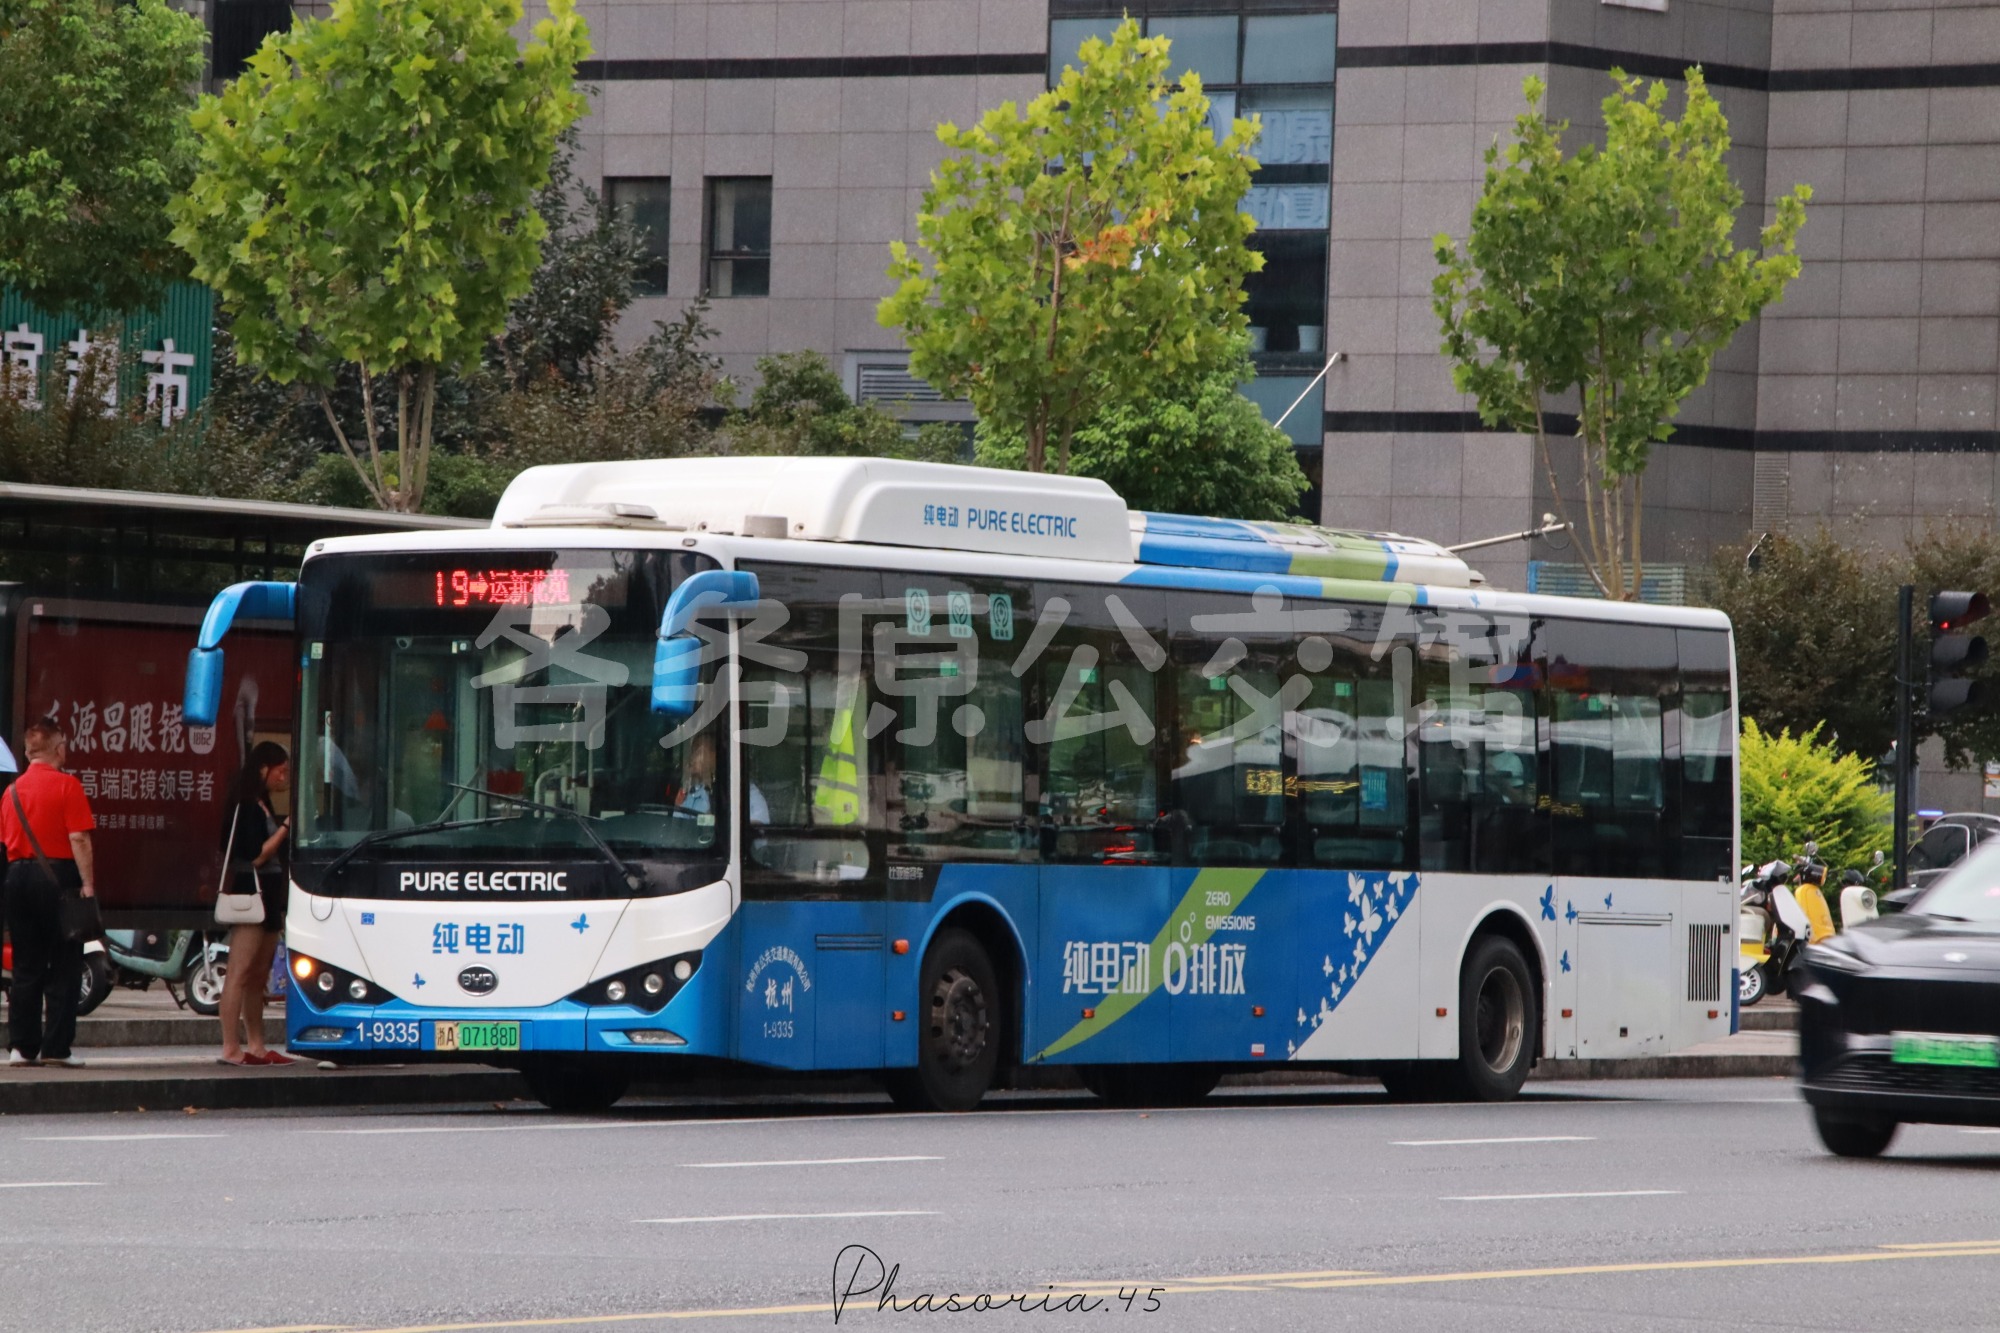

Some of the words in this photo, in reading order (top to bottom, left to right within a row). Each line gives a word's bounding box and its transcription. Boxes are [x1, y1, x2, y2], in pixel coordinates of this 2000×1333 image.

[924, 504, 959, 528] 纯电动
[967, 508, 1007, 532] PURE
[1011, 512, 1077, 538] ELECTRIC
[436, 571, 468, 605] 19
[45, 699, 186, 753] 源昌眼镜
[400, 871, 459, 892] PURE
[464, 871, 568, 892] ELECTRIC
[1205, 891, 1231, 907] ZERO
[1205, 915, 1256, 931] EMISSIONS
[432, 922, 525, 955] 纯电动
[461, 973, 494, 987] BYD
[1063, 941, 1150, 995] 纯电动
[764, 974, 794, 1014] 杭州
[356, 1021, 420, 1043] 1-9335
[763, 1020, 794, 1039] 1-9335
